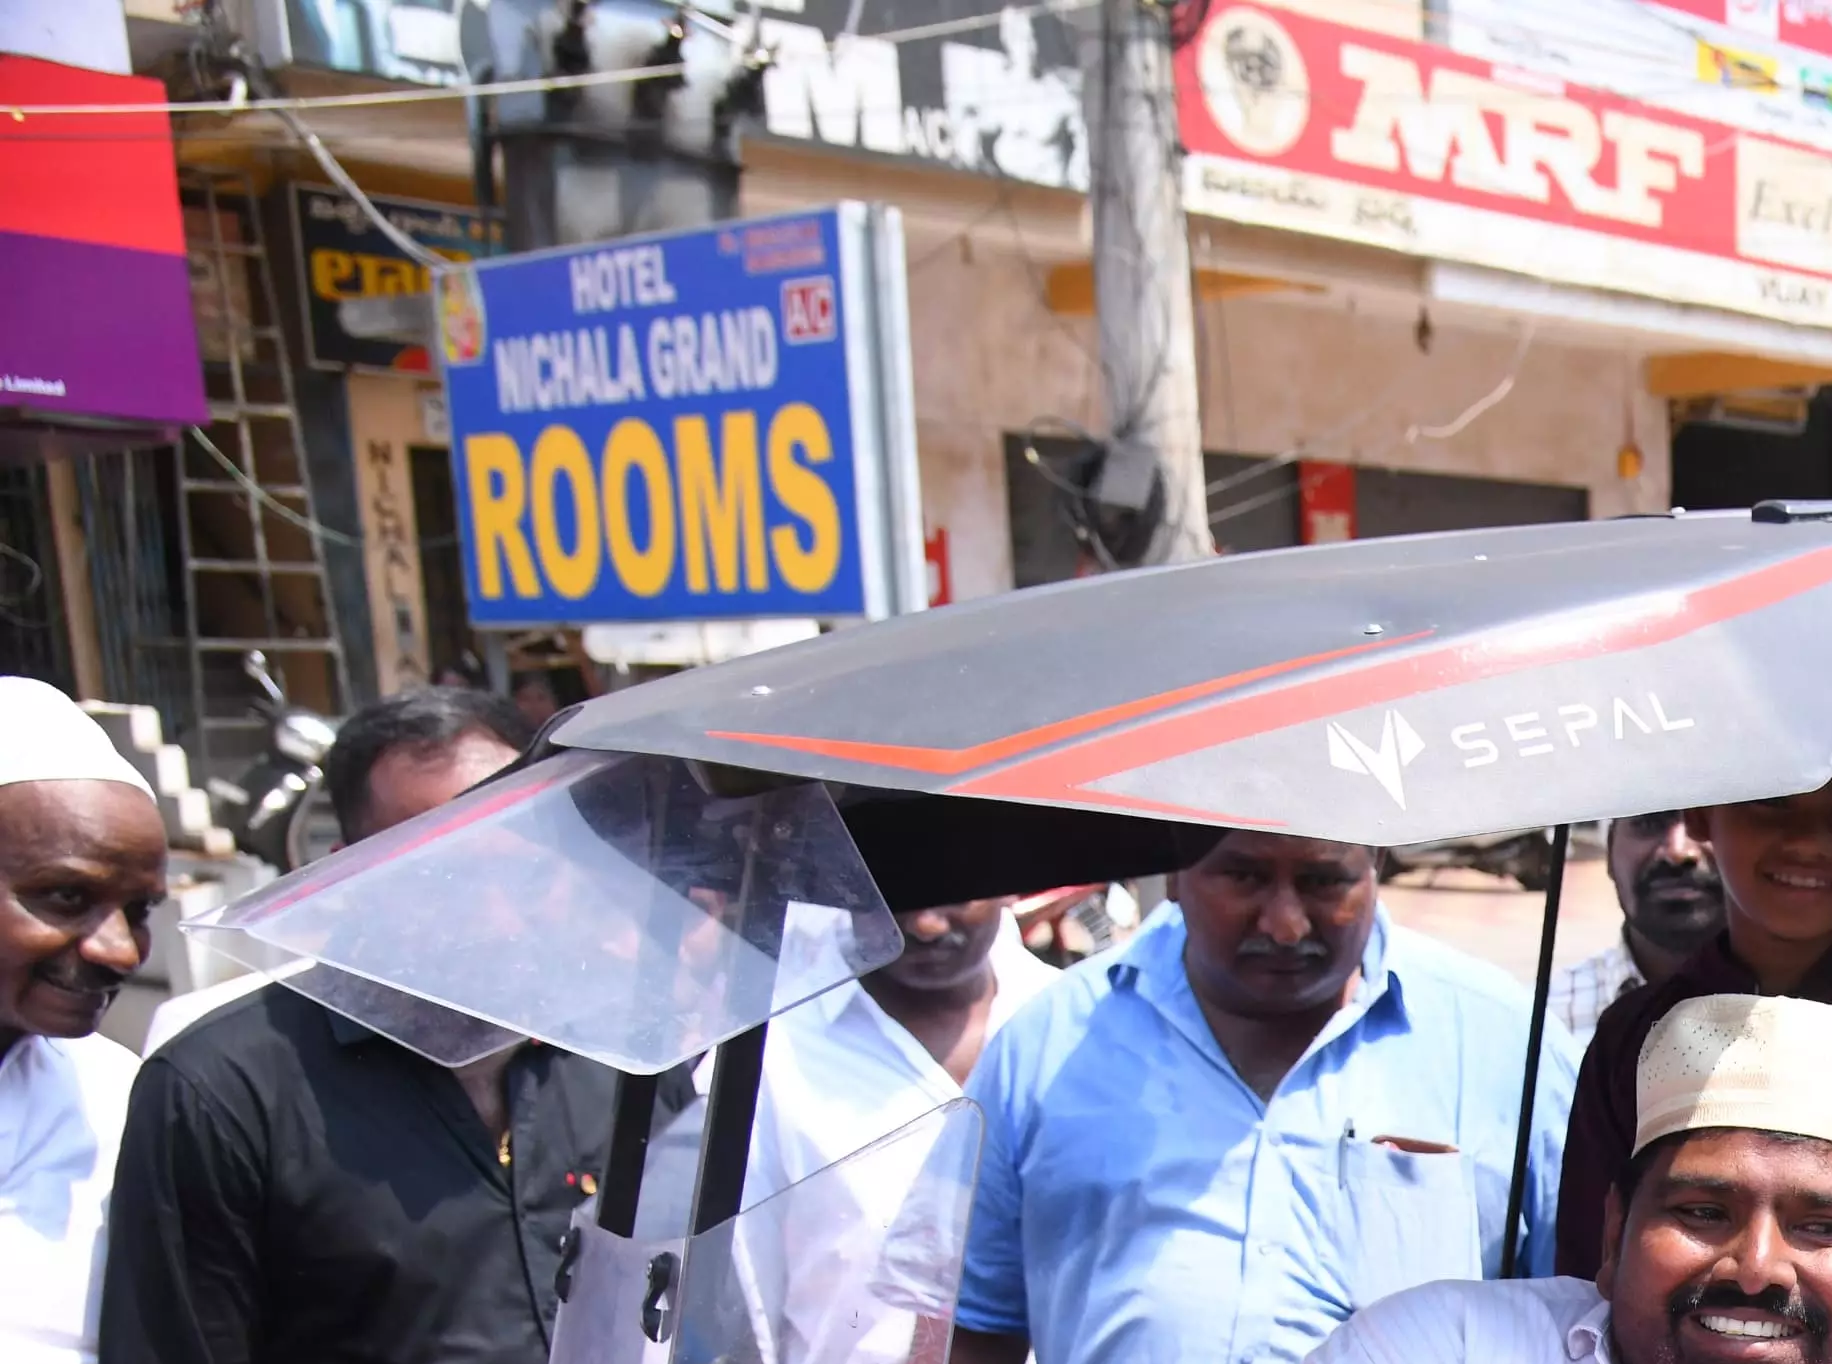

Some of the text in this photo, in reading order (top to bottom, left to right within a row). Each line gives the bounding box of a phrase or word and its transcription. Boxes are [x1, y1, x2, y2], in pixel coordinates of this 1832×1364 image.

[1331, 42, 1704, 228] MRF
[569, 244, 677, 315] HOTEL
[494, 305, 779, 414] NICHALA GRAND
[463, 402, 842, 600] ROOMS
[1450, 691, 1695, 769] SEPAL
